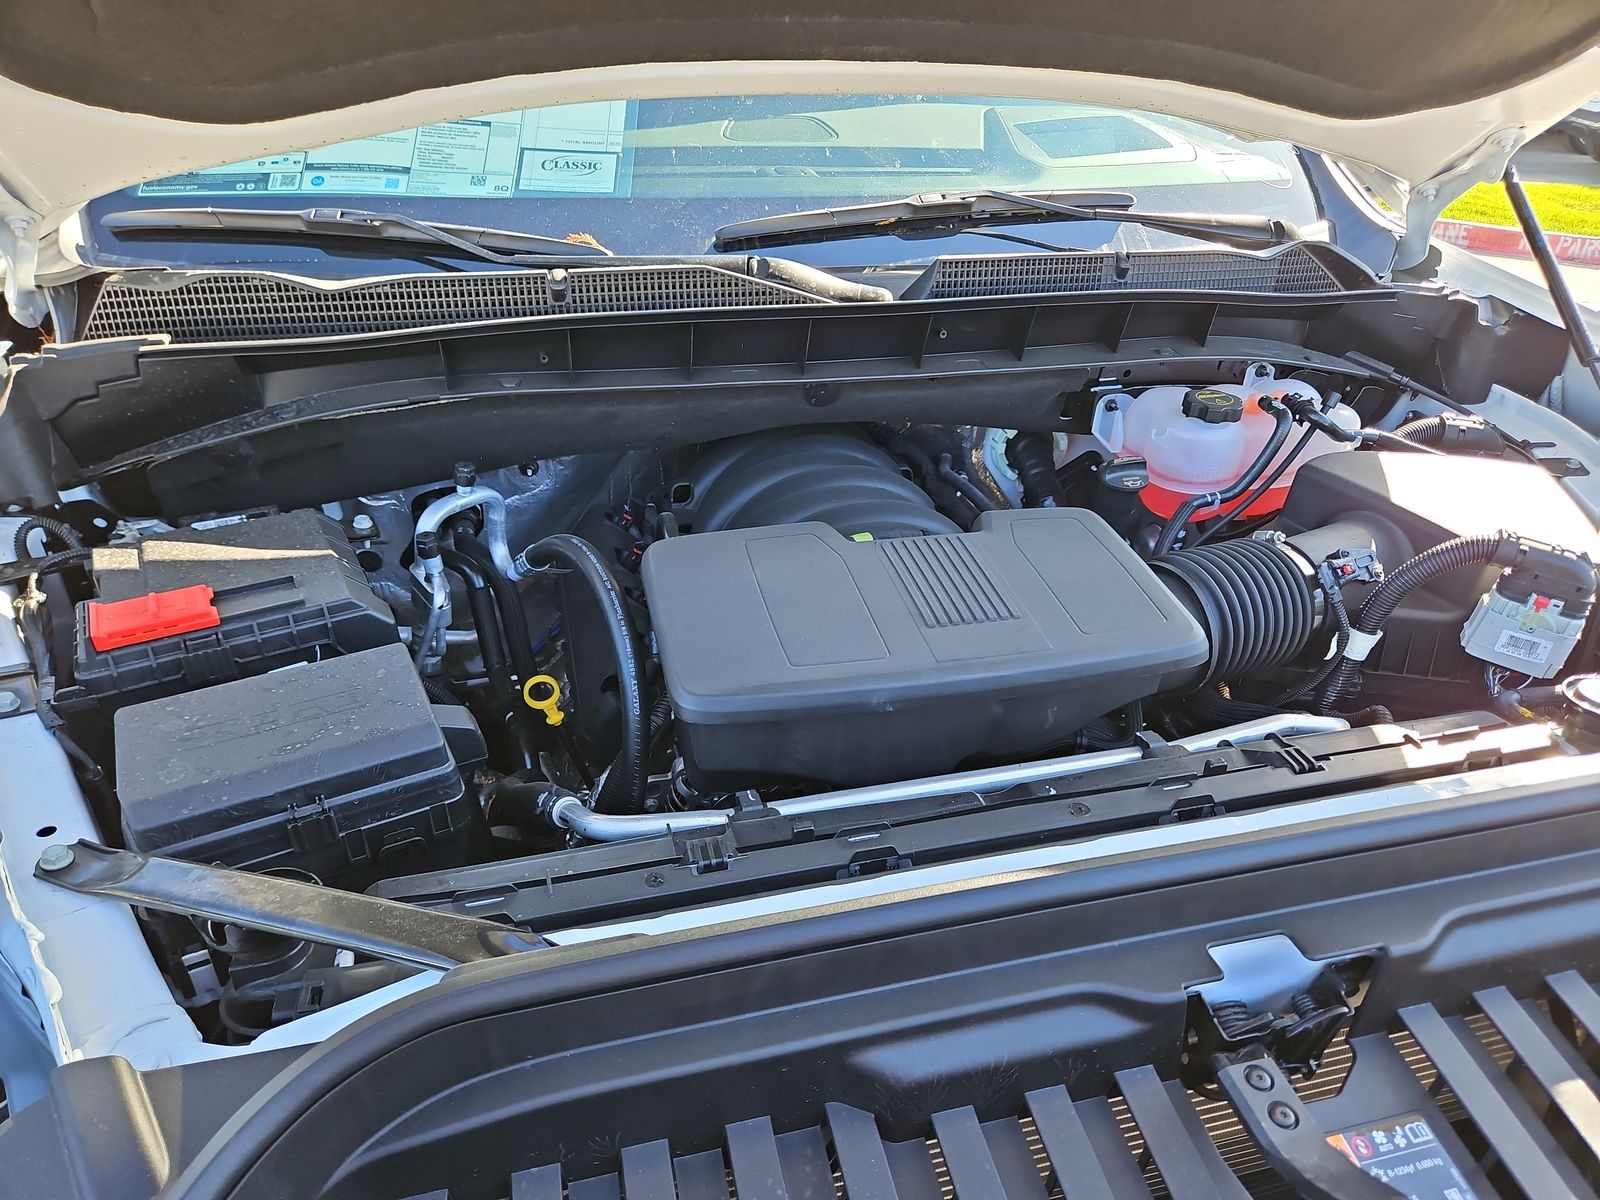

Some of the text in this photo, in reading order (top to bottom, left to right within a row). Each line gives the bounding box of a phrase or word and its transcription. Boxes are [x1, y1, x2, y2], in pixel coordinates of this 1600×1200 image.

[541, 159, 602, 171] CLASSIC
[142, 184, 199, 192] fueleconomy.gov
[630, 678, 640, 715] GALAXY
[1379, 1143, 1394, 1153] AUTO
[1387, 1163, 1415, 1179] R-1234yf
[1433, 1157, 1444, 1167] kg
